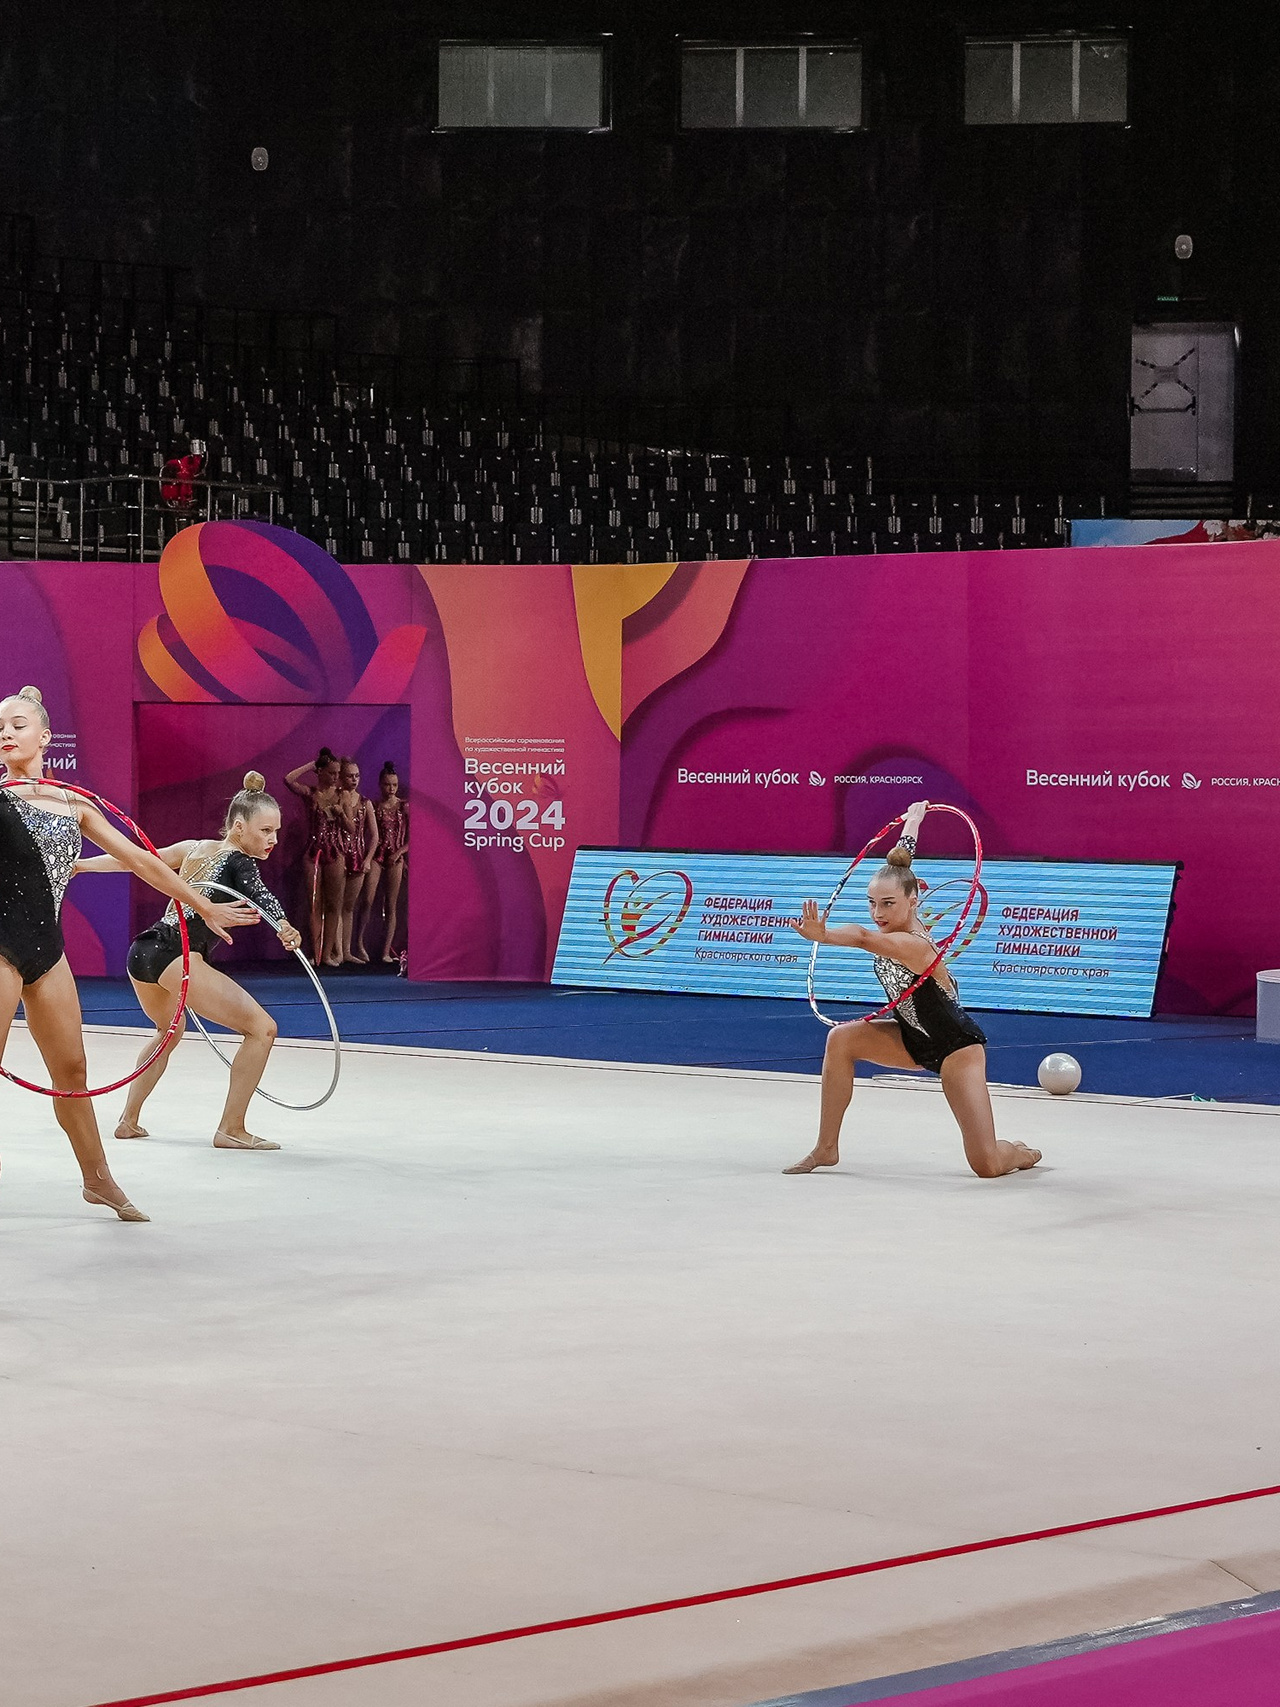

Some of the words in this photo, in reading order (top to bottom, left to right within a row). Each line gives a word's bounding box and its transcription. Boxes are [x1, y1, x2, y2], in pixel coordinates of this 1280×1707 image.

[464, 758, 566, 775] Весенний
[677, 768, 751, 784] Весенний
[754, 768, 800, 788] кубок
[834, 775, 869, 785] РОССИЯ,
[870, 775, 923, 784] КРАСНОЯРСК
[1026, 769, 1113, 786] Весенний
[1118, 770, 1171, 791] кубок
[1211, 777, 1251, 787] РОССИЯ,
[464, 777, 524, 799] кубок
[464, 799, 566, 830] 2024
[464, 832, 524, 853] Spring
[529, 832, 566, 852] Cup
[704, 897, 773, 912] ФЕДЕРАЦИЯ
[1001, 906, 1080, 923] ФЕДЕРАЦИЯ
[698, 930, 774, 944] ГИМНАСТИКИ
[998, 924, 1118, 941] ХУДОЖЕСТВЕННОЙ
[694, 947, 771, 963] Красноярского
[774, 955, 798, 964] края
[995, 942, 1081, 957] ГИМНАСТИКИ
[991, 960, 1079, 977] Красноярского
[1081, 968, 1110, 979] края
